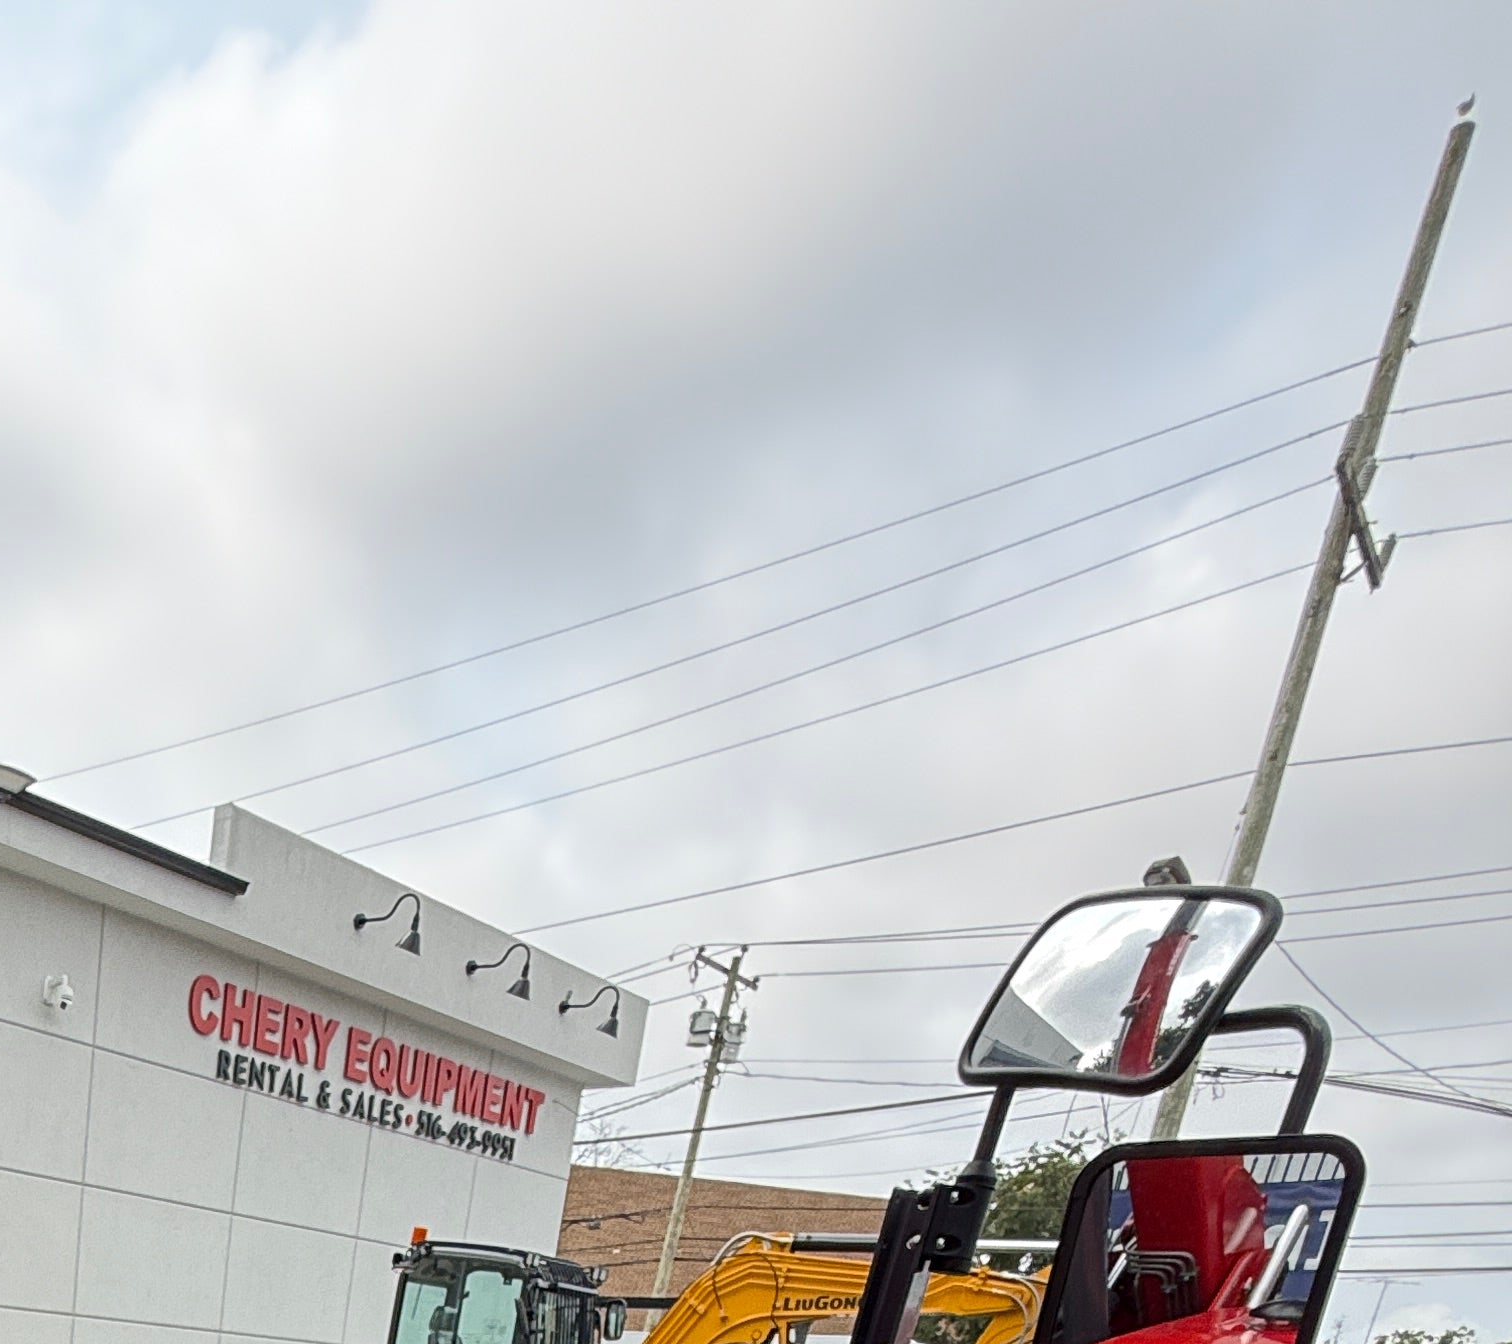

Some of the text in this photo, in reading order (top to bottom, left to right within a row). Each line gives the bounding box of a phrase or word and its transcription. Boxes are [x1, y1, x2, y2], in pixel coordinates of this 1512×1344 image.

[189, 973, 546, 1134] CHERY EQUIPMENT
[216, 1048, 309, 1106] RENTAL
[316, 1080, 332, 1110] &
[338, 1087, 404, 1130] SALES
[782, 1295, 861, 1311] LIUGON
